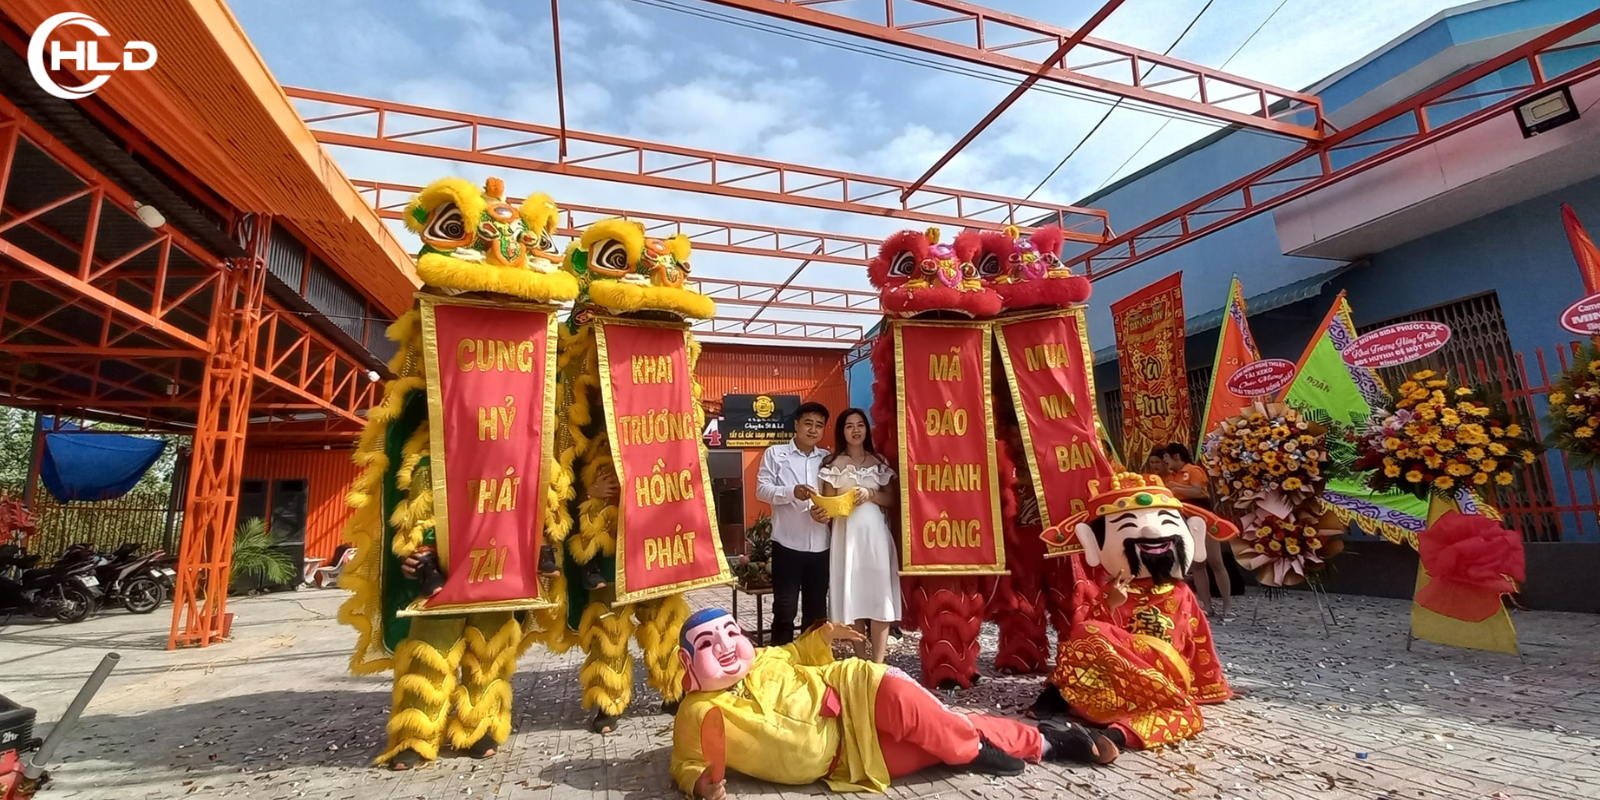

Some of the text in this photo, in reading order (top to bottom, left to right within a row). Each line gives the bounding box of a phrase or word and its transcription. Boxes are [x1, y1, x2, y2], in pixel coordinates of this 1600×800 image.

[457, 338, 535, 374] CUNG
[1023, 344, 1070, 372] MUA
[1343, 341, 1360, 356] CHÚC
[1379, 328, 1397, 337] BIDA
[631, 354, 674, 386] KHAI
[928, 345, 963, 382] MÃ
[478, 395, 517, 441] HỶ
[925, 400, 968, 436] ĐÁO
[1039, 393, 1076, 421] MA
[618, 407, 694, 446] TRƯƠNG
[703, 418, 721, 446] 4
[635, 457, 694, 508] HỒNG
[913, 455, 982, 492] THÀNH
[643, 523, 697, 571] PHÁT
[922, 511, 982, 549] CÔNG
[468, 537, 509, 585] TÀI
